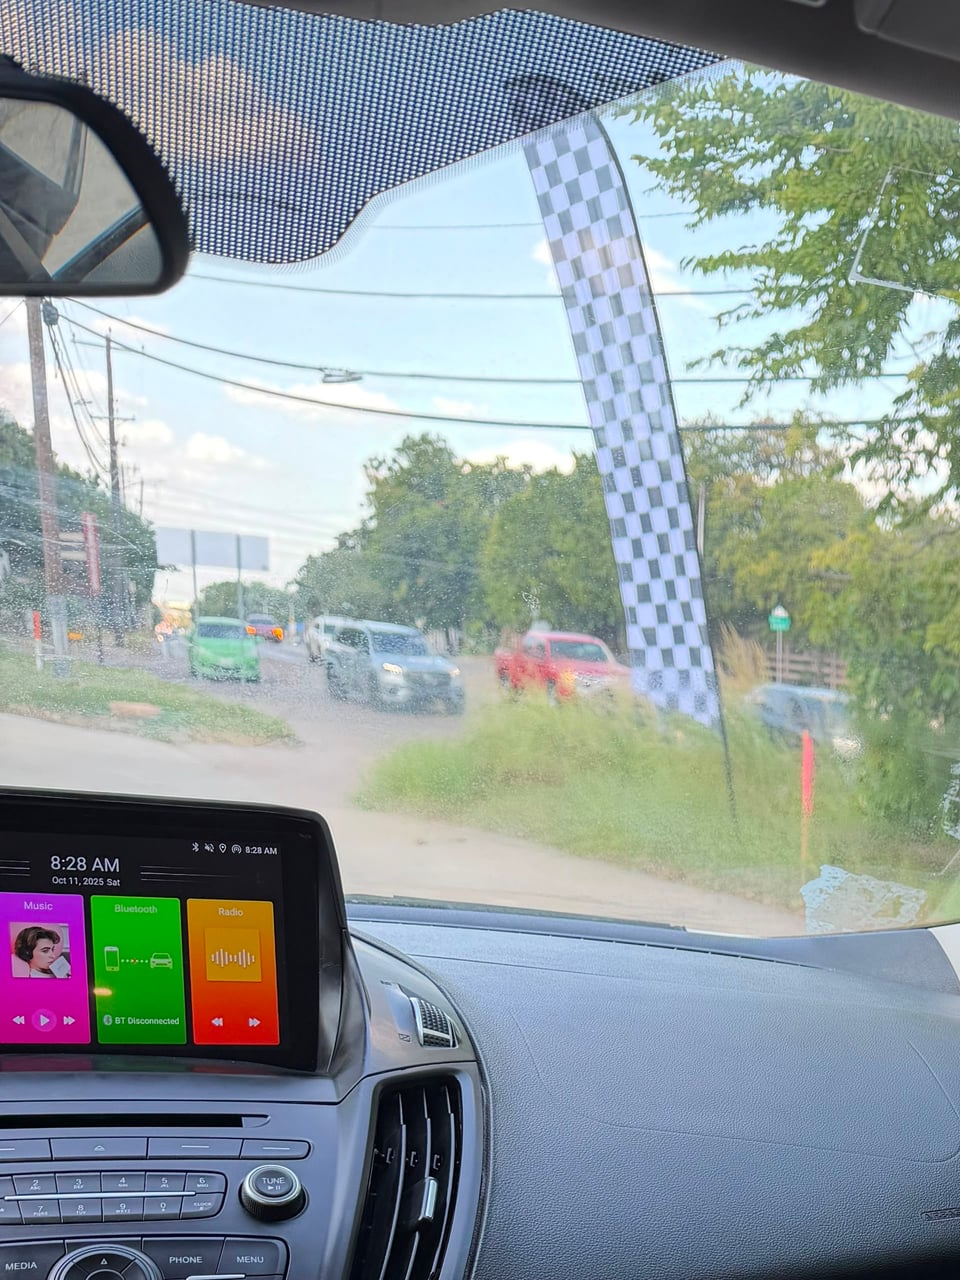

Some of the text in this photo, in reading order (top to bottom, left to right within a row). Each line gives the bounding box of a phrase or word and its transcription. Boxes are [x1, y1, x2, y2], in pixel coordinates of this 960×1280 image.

[245, 846, 278, 855] 8:28 AM
[50, 855, 120, 873] 8:28 AM
[52, 876, 120, 887] Oct 11, 2025 Sat
[24, 901, 53, 911] Music
[114, 904, 158, 914] Bluetooth
[218, 907, 244, 917] Radio
[114, 1016, 180, 1025] BT Disconnected
[262, 1177, 285, 1185] TUNE
[169, 1256, 203, 1264] PHONE
[236, 1255, 264, 1264] MENU
[5, 1261, 38, 1271] MEDIA
